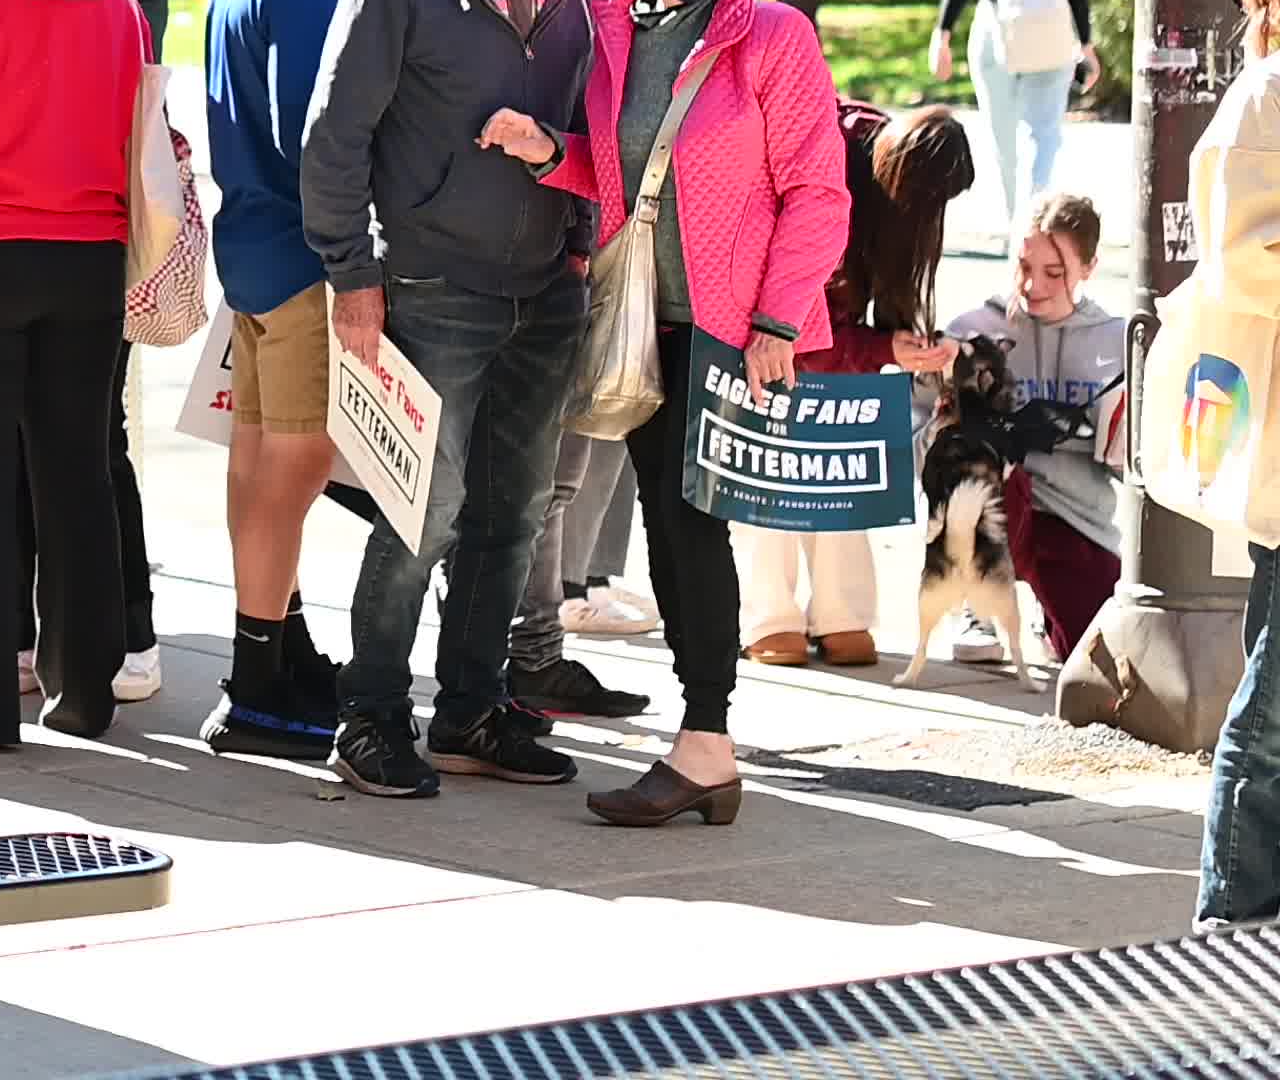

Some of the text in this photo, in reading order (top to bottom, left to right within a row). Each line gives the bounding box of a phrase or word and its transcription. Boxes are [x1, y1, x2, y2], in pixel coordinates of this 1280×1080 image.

[704, 363, 882, 425] EAGLES FANS
[347, 381, 413, 484] FETTERMAN
[708, 428, 868, 481] FETTERMAN
[765, 420, 788, 436] FOR
[777, 499, 854, 511] PENNSYLVANIA
